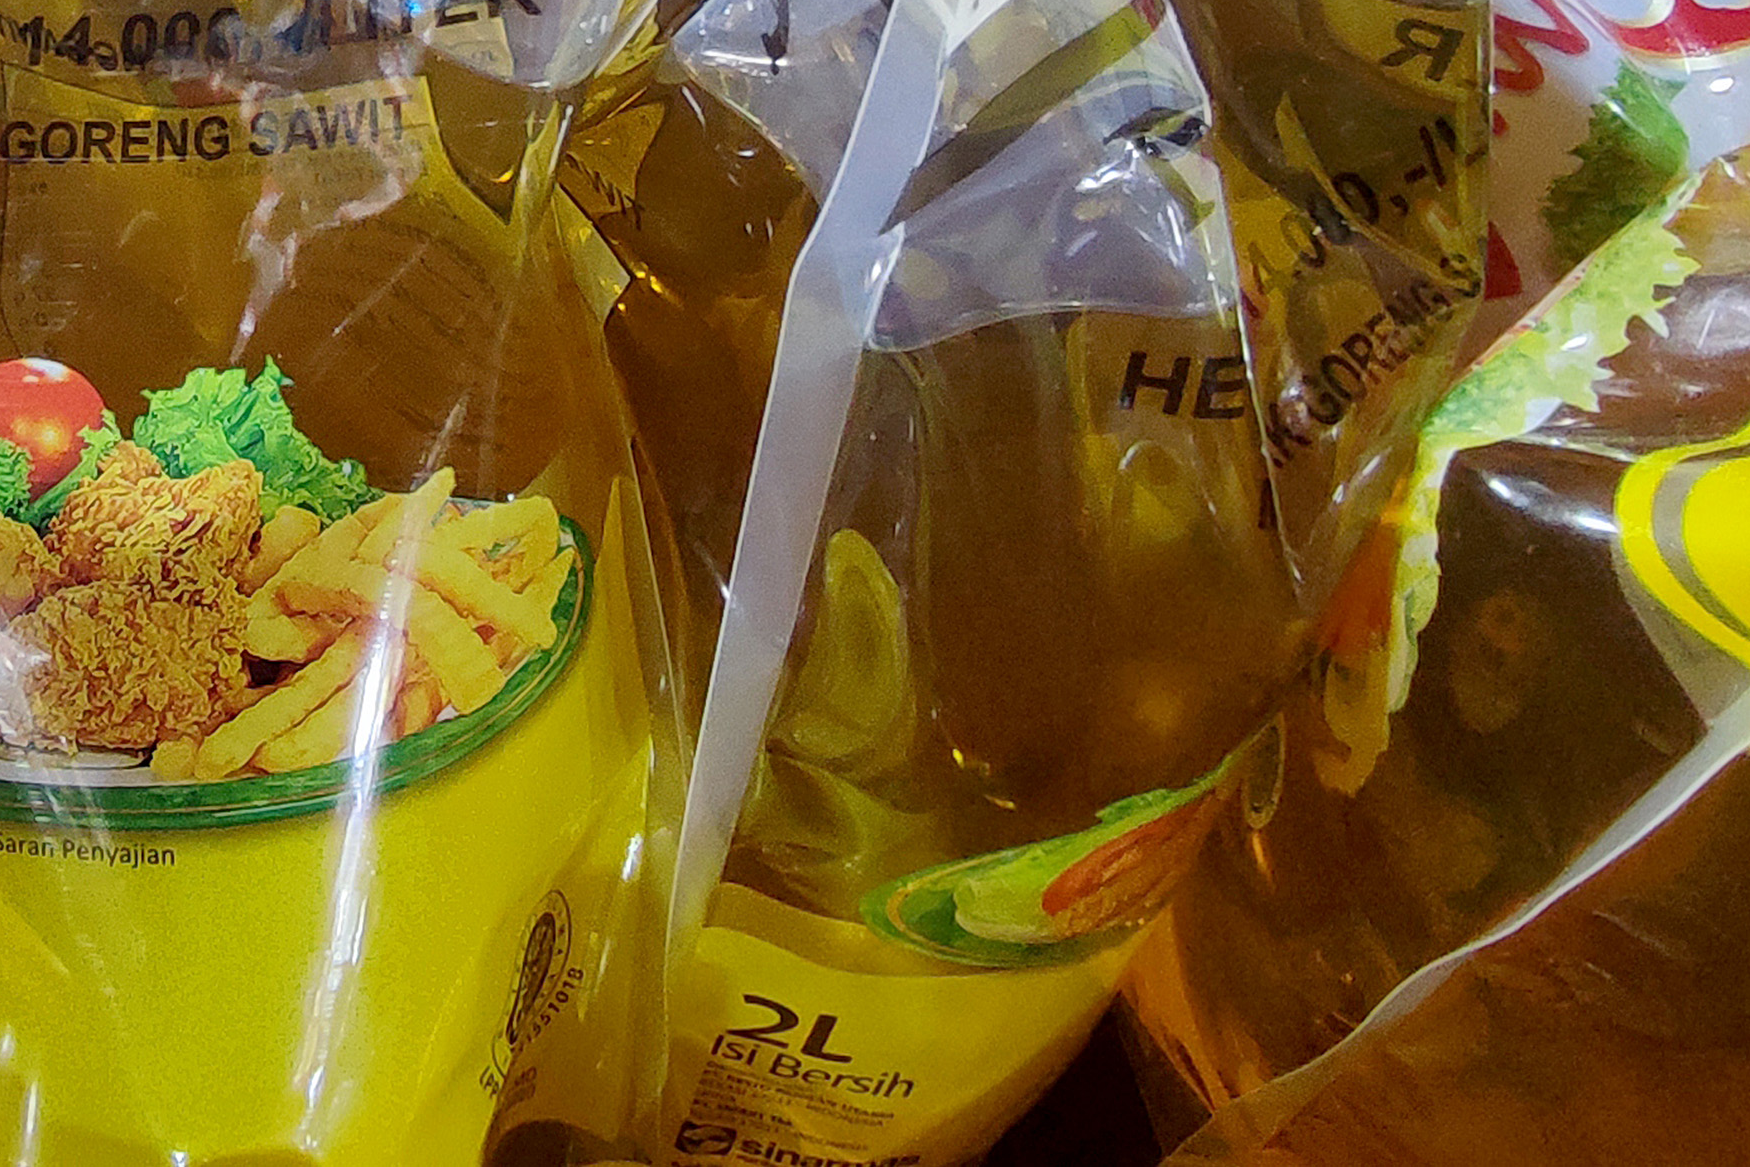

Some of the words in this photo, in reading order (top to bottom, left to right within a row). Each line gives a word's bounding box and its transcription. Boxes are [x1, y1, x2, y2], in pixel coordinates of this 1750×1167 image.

[0, 115, 232, 165] GORENG
[249, 92, 414, 157] SAWIT
[1118, 349, 1249, 422] HE
[60, 841, 177, 870] Penyajian
[725, 993, 853, 1064] 2L
[710, 1034, 762, 1066] Isi
[768, 1051, 916, 1099] Bersih
